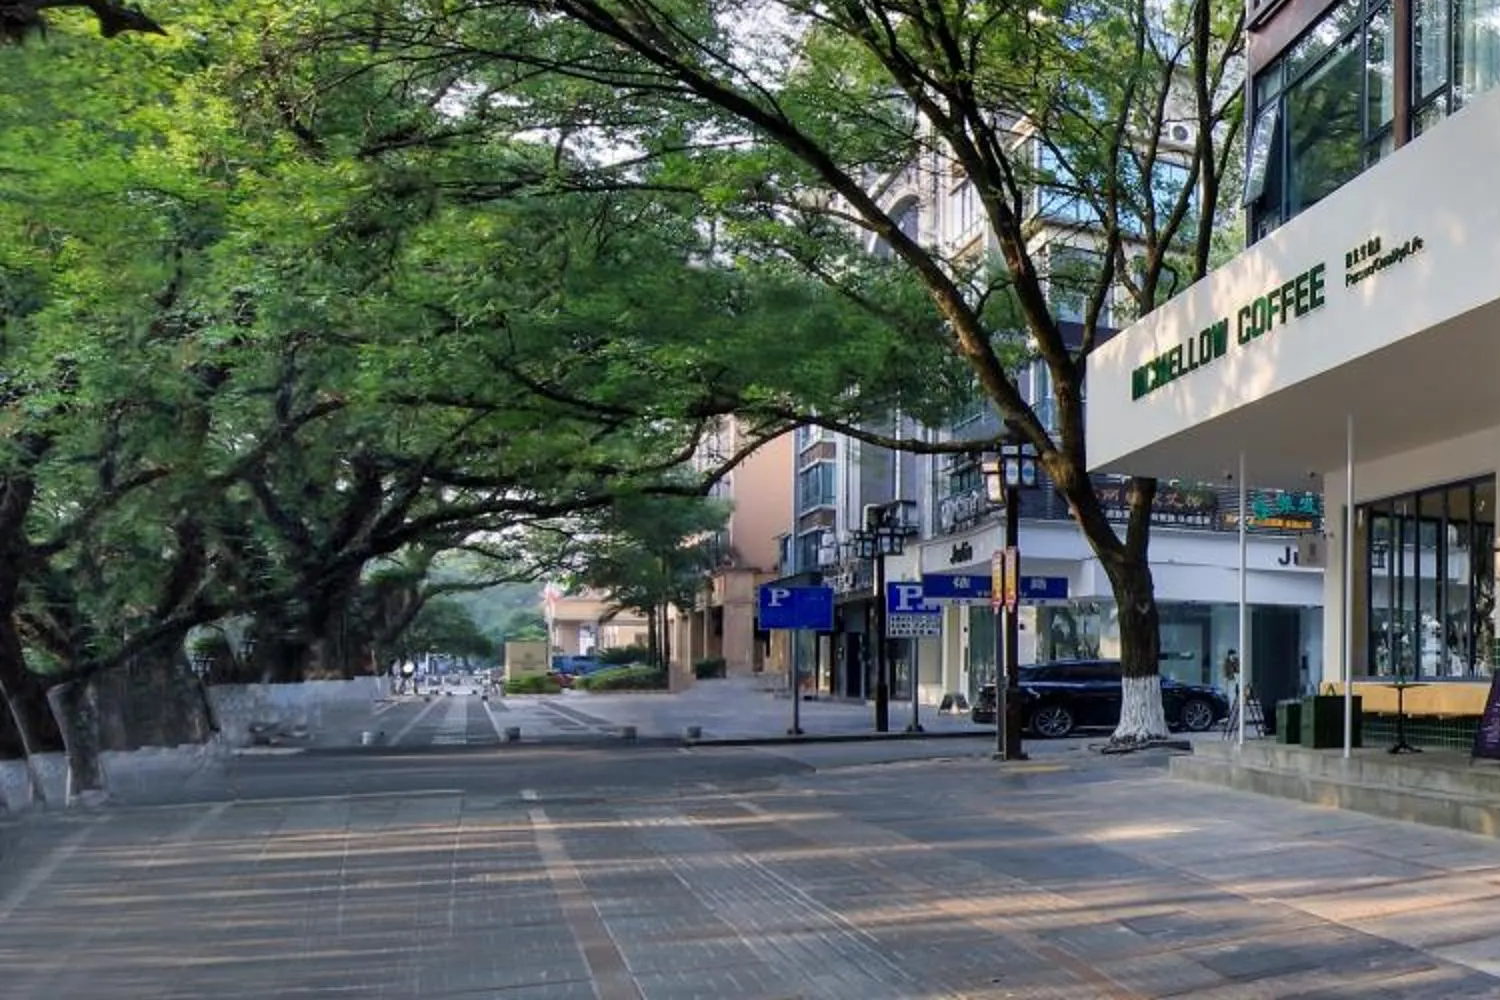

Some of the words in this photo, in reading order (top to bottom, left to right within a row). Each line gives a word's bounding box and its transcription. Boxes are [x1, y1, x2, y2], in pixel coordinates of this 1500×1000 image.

[1237, 262, 1325, 346] COFFEE
[767, 588, 791, 607] P
[895, 585, 924, 611] P
